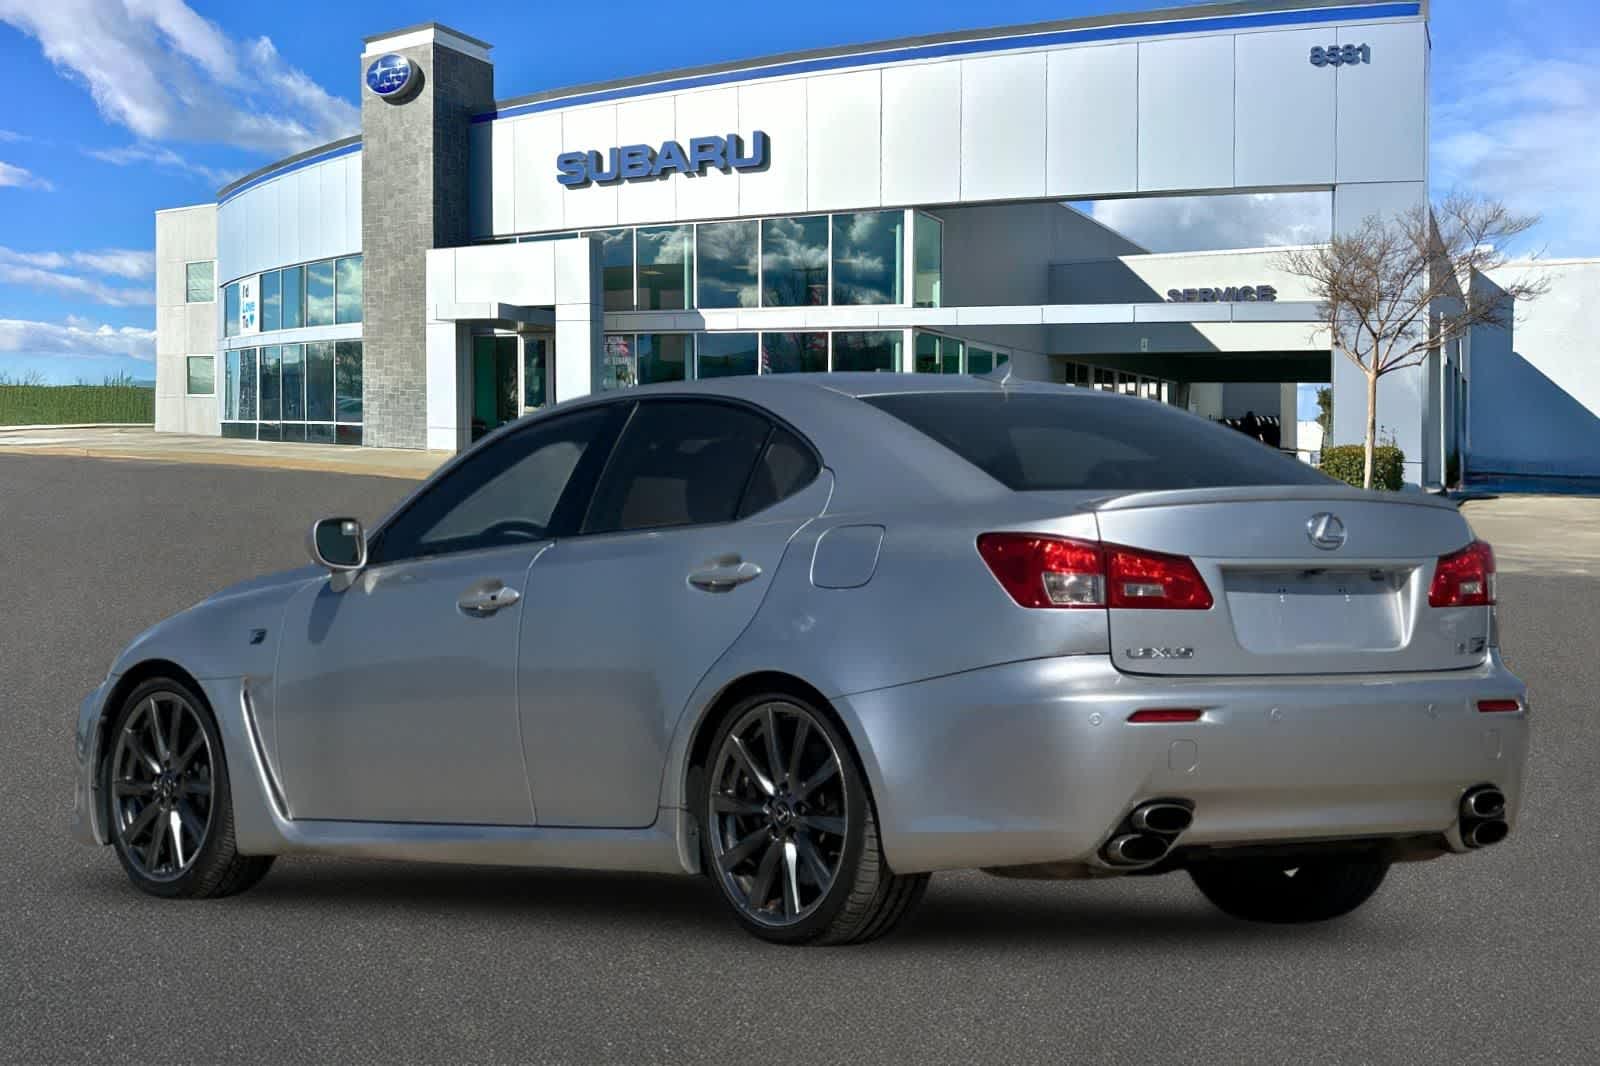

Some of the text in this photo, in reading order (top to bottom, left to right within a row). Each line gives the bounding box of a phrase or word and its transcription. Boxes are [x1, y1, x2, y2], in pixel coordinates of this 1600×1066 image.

[557, 130, 771, 190] SUBARU
[1167, 285, 1277, 302] SERVICE
[1126, 647, 1194, 659] LEXUS
